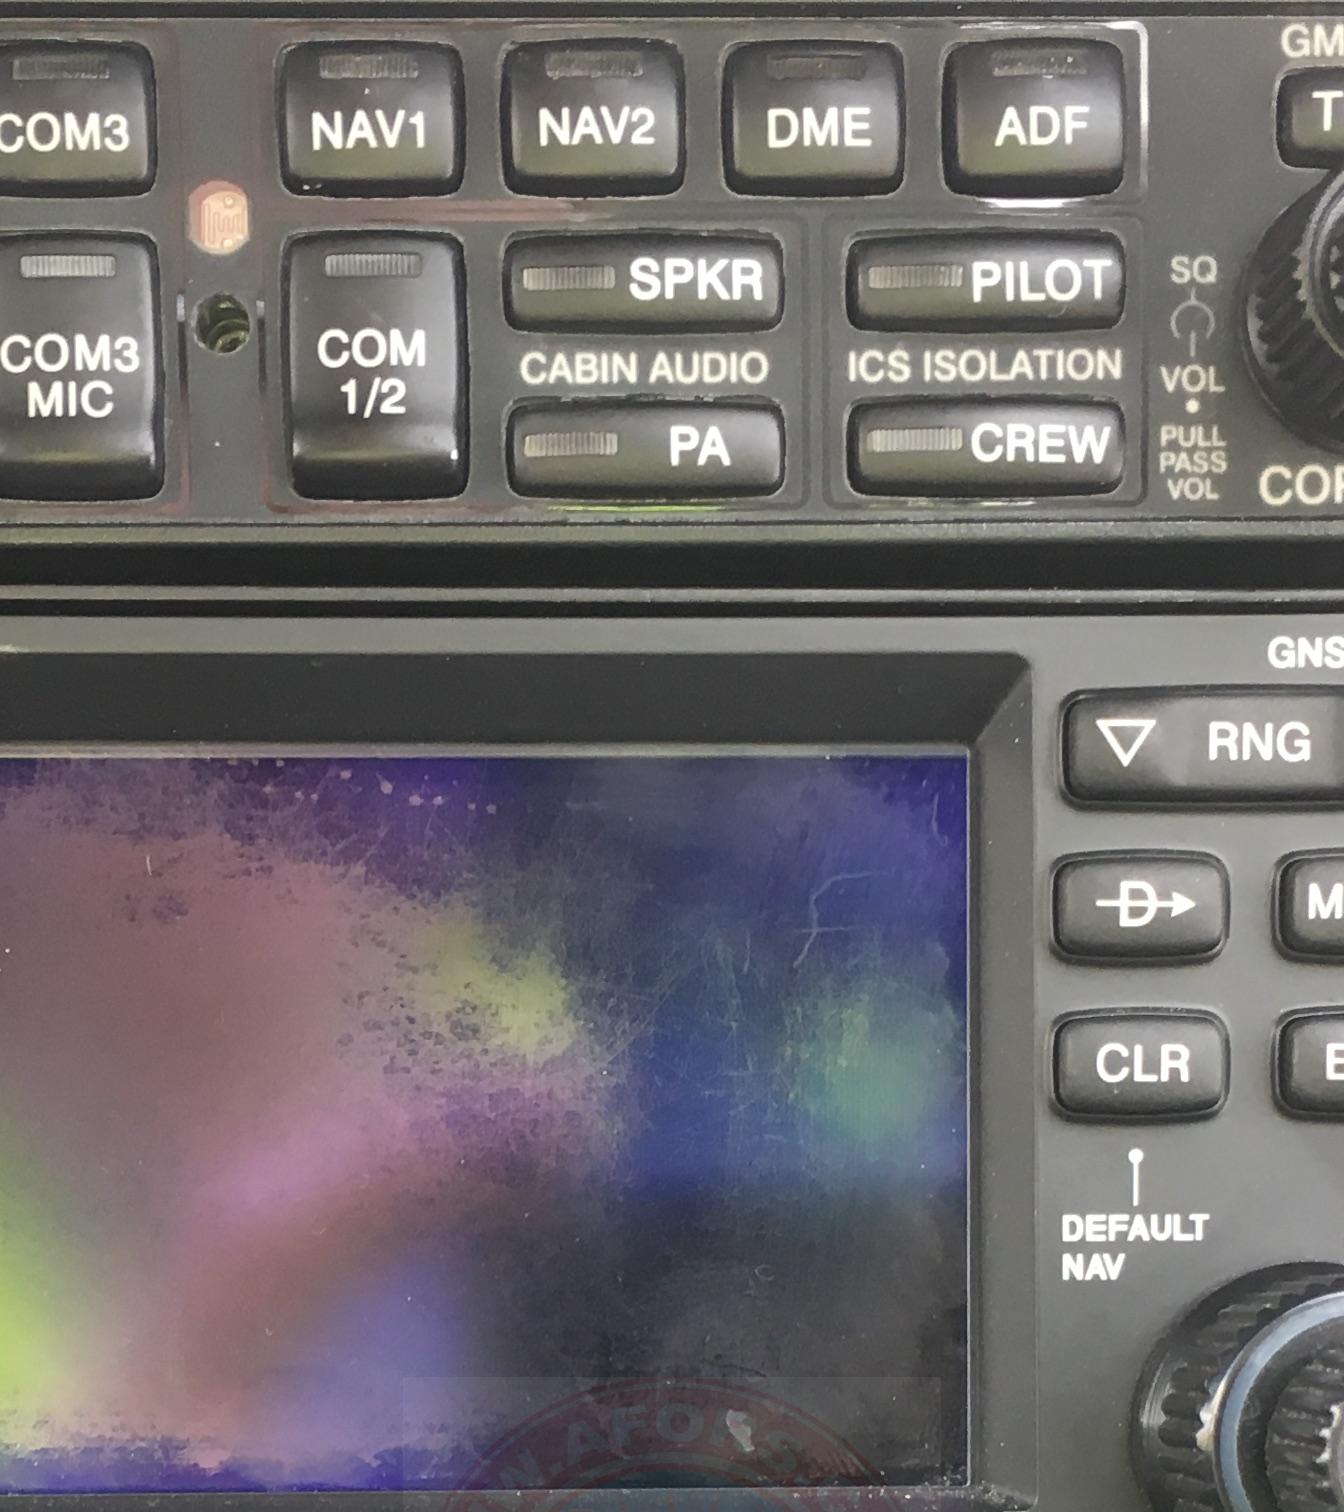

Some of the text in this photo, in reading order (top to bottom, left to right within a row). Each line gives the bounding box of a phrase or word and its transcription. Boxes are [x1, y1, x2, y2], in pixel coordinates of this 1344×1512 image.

[311, 109, 426, 151] NAV1
[539, 105, 656, 147] NAV2
[767, 105, 873, 149] DME
[994, 104, 1091, 147] ADF
[629, 256, 764, 301] SPKR
[971, 257, 1114, 303] PILOT
[1170, 255, 1218, 284] SQ
[0, 333, 141, 374] COM3
[317, 327, 427, 369] COM
[519, 350, 769, 385] CABIN AUDIO
[848, 348, 1122, 384] ICS ISOLATION
[27, 379, 114, 418] MIC
[340, 376, 407, 419] 1/2
[1159, 363, 1226, 394] VOL
[669, 424, 731, 466] PA
[970, 415, 1112, 464] CREW
[1160, 424, 1227, 449] PULL
[1159, 450, 1228, 475] PASS
[1166, 476, 1220, 501] VOL
[1208, 720, 1311, 763] RNG
[1096, 1042, 1191, 1083] CLR
[1062, 1213, 1211, 1242] DEFAULT
[1062, 1252, 1126, 1281] NAV
